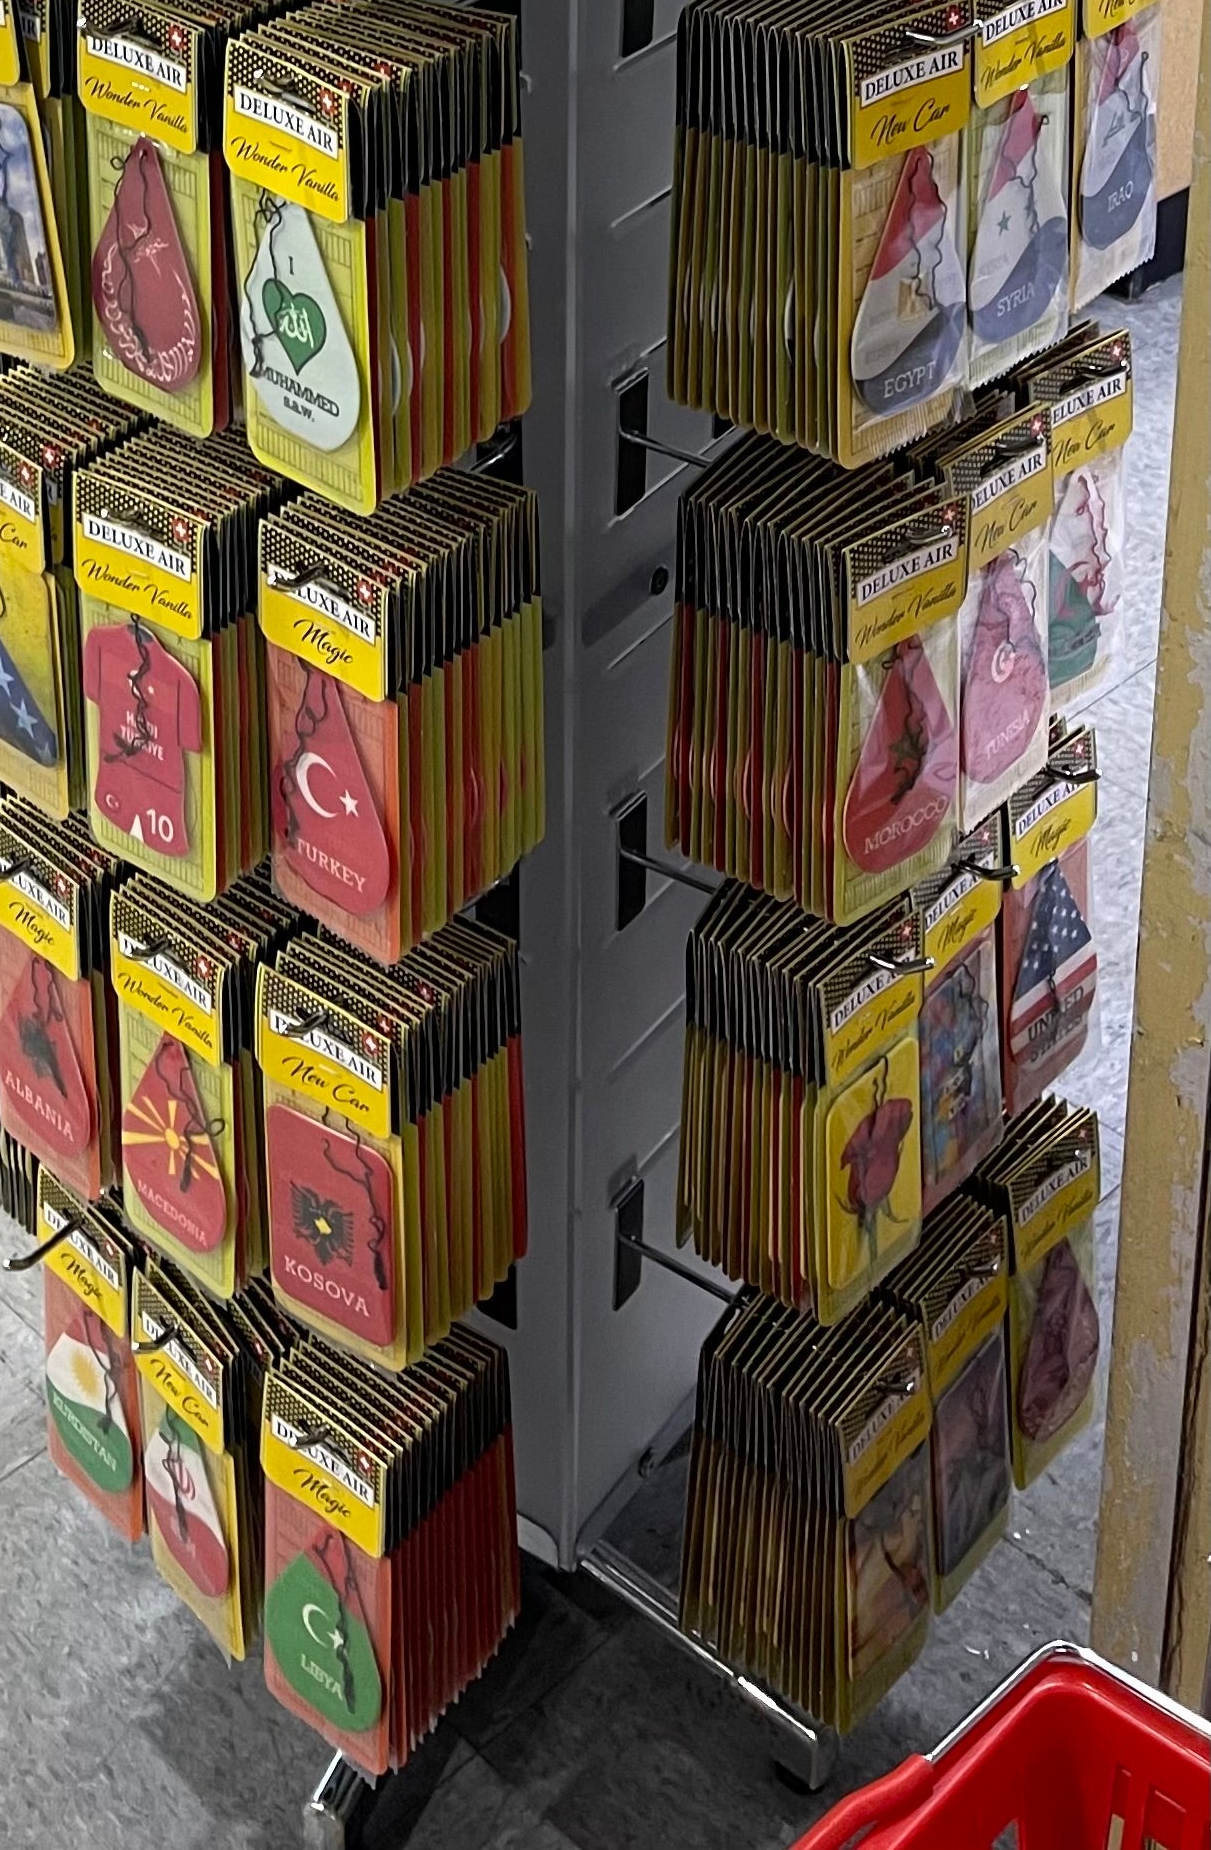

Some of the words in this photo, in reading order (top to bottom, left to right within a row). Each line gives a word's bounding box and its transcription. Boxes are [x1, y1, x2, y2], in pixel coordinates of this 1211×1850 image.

[985, 2, 1036, 41] DELUXE
[91, 36, 155, 73] DELUXE
[156, 63, 183, 87] AIR
[864, 60, 925, 101] DELUXE
[926, 50, 959, 76] AIR
[85, 76, 141, 110] Wonder
[142, 98, 188, 134] Vanilla
[240, 92, 305, 136] DELUXE
[307, 125, 333, 153] AIR
[870, 114, 908, 147] New
[912, 98, 951, 133] Car
[230, 136, 288, 173] Wonder
[291, 163, 339, 202] Vanilla
[997, 282, 1036, 317] SYRIA
[884, 362, 936, 399] EGYPT
[1052, 390, 1094, 423] ELUXE
[1096, 378, 1122, 402] AIR
[1018, 454, 1043, 476] AIR
[10, 486, 32, 517] AIR
[88, 520, 155, 559] DELUXE
[157, 549, 186, 576] AIR
[81, 558, 141, 593] Wonder
[143, 583, 192, 620] Vanilla
[861, 558, 921, 602] DELUXE
[923, 544, 953, 569] AIR
[293, 618, 353, 665] Magic
[343, 610, 371, 638] AIR
[146, 808, 174, 843] 10
[864, 794, 949, 855] MOROCCO
[297, 838, 366, 893] TURKEY
[8, 901, 54, 946] Magic
[45, 898, 67, 927] AIR
[118, 972, 169, 1012] Wonder
[171, 1008, 213, 1049] Vanilla
[183, 987, 208, 1008] AIR
[281, 1056, 330, 1089] New
[332, 1083, 370, 1114] Car
[348, 1057, 377, 1084] AIR
[4, 1069, 74, 1143] ALBANIA
[96, 1255, 115, 1282] AIR
[283, 1255, 371, 1318] KOSOVA
[150, 1359, 179, 1397] New
[195, 1367, 214, 1397] AIR
[293, 1467, 351, 1517] Magic
[343, 1474, 369, 1500] AIR
